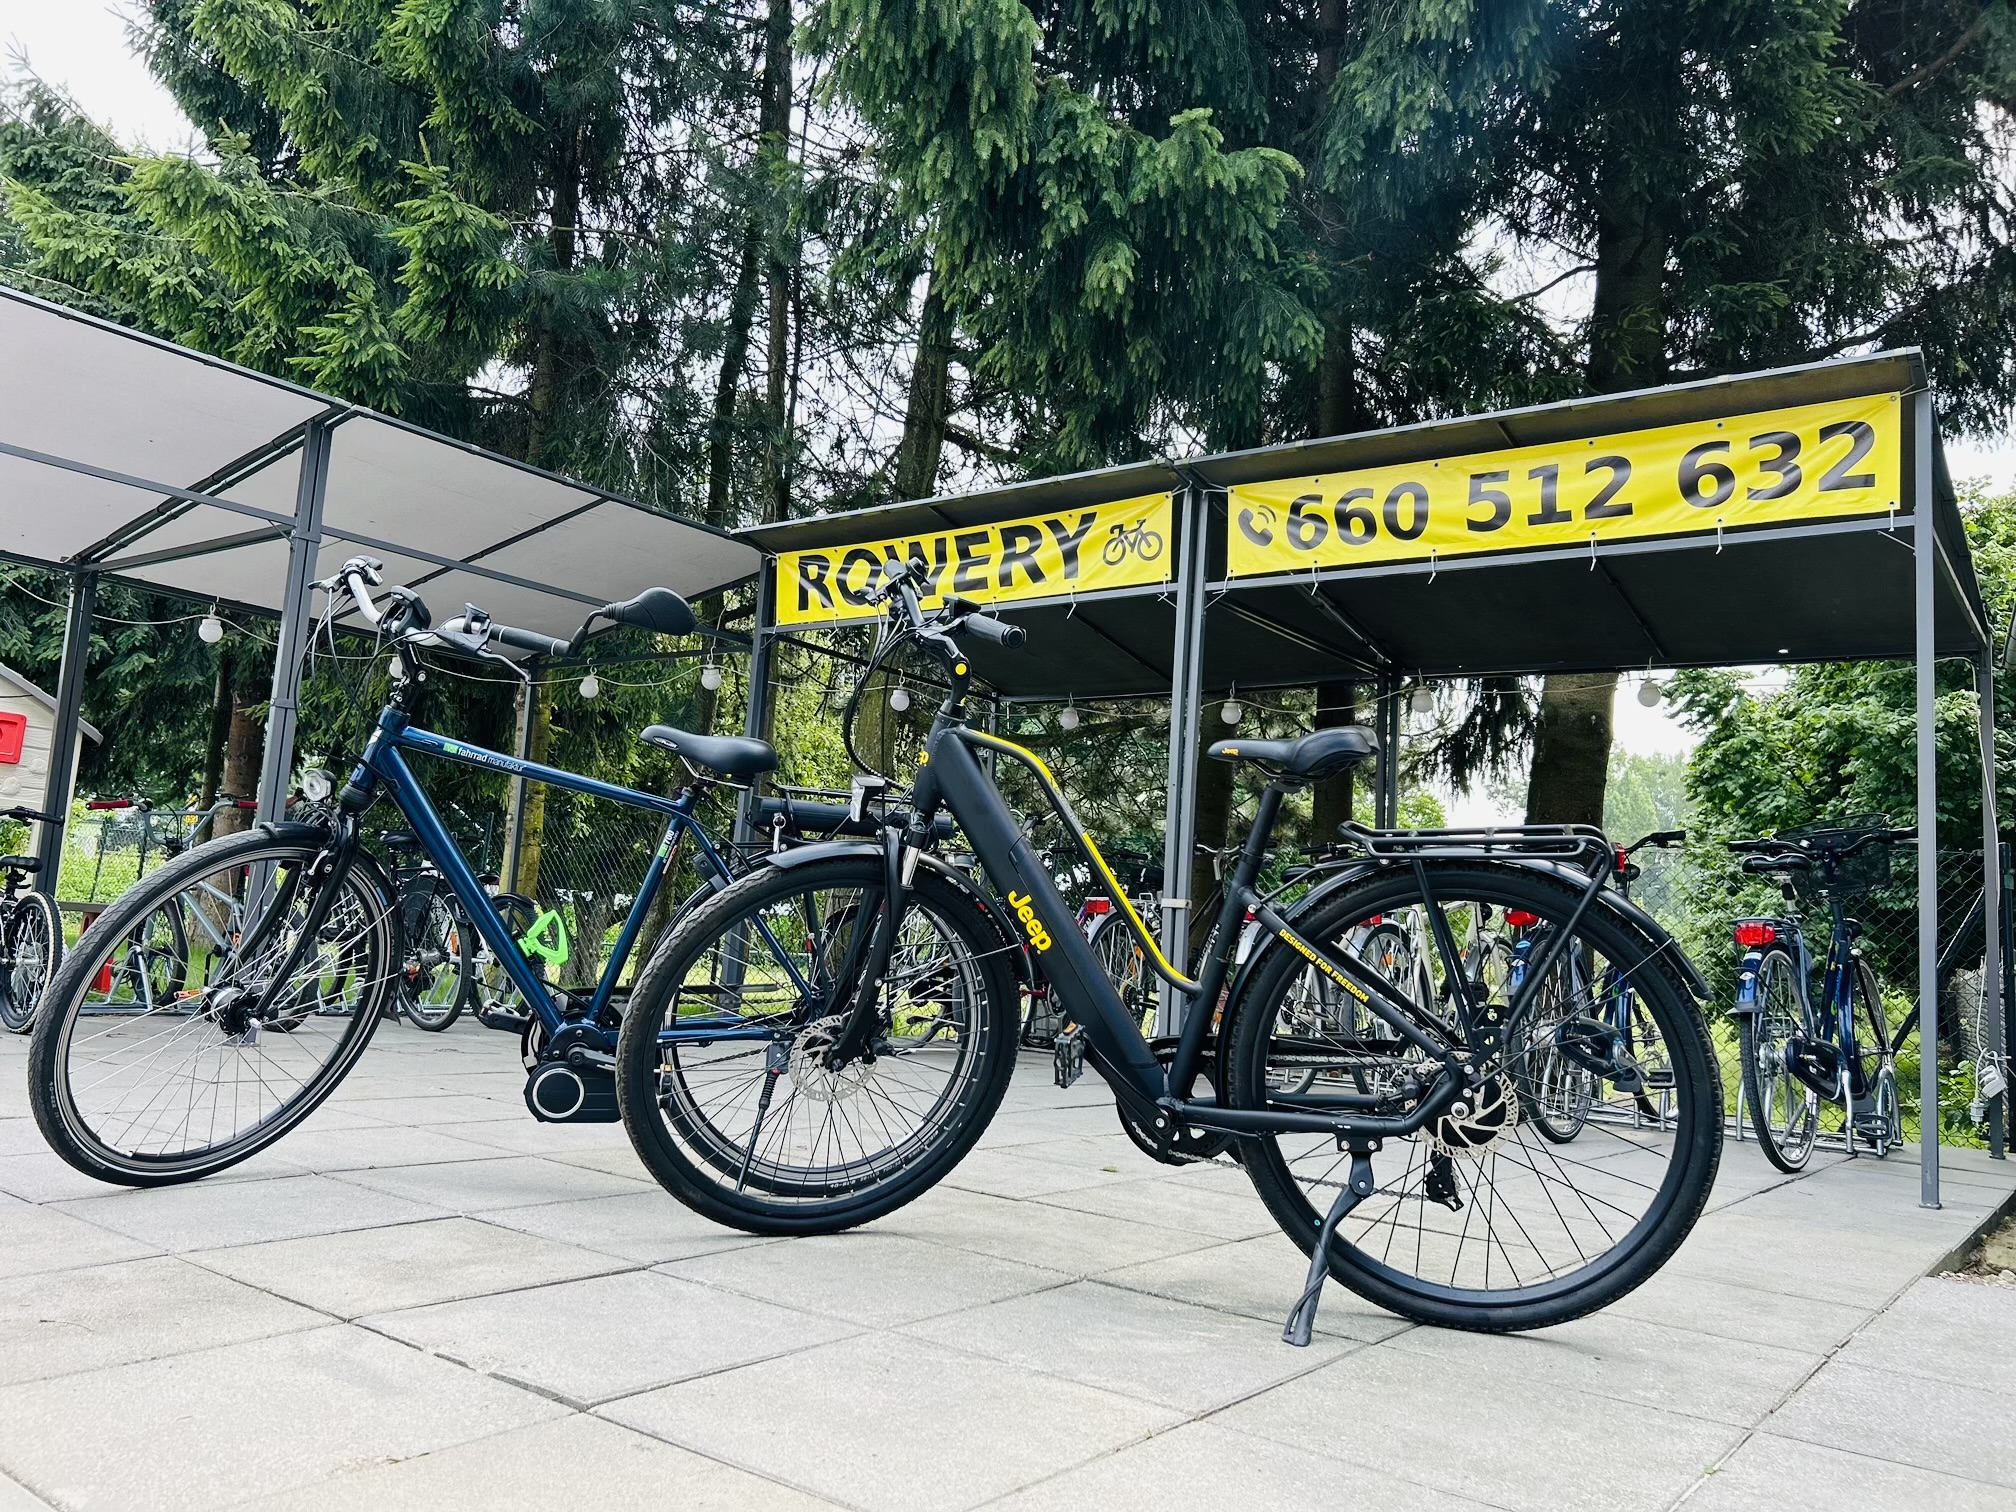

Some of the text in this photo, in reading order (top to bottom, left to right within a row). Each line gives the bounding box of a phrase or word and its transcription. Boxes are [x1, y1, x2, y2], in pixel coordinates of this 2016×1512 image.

[1285, 420, 1876, 551] 660 512 632
[797, 511, 1098, 611] ROWERY
[1221, 747, 1238, 756] Jeep
[1008, 890, 1052, 951] Jeep
[1279, 928, 1370, 1003] DESIGNED FOR FREEDOM
